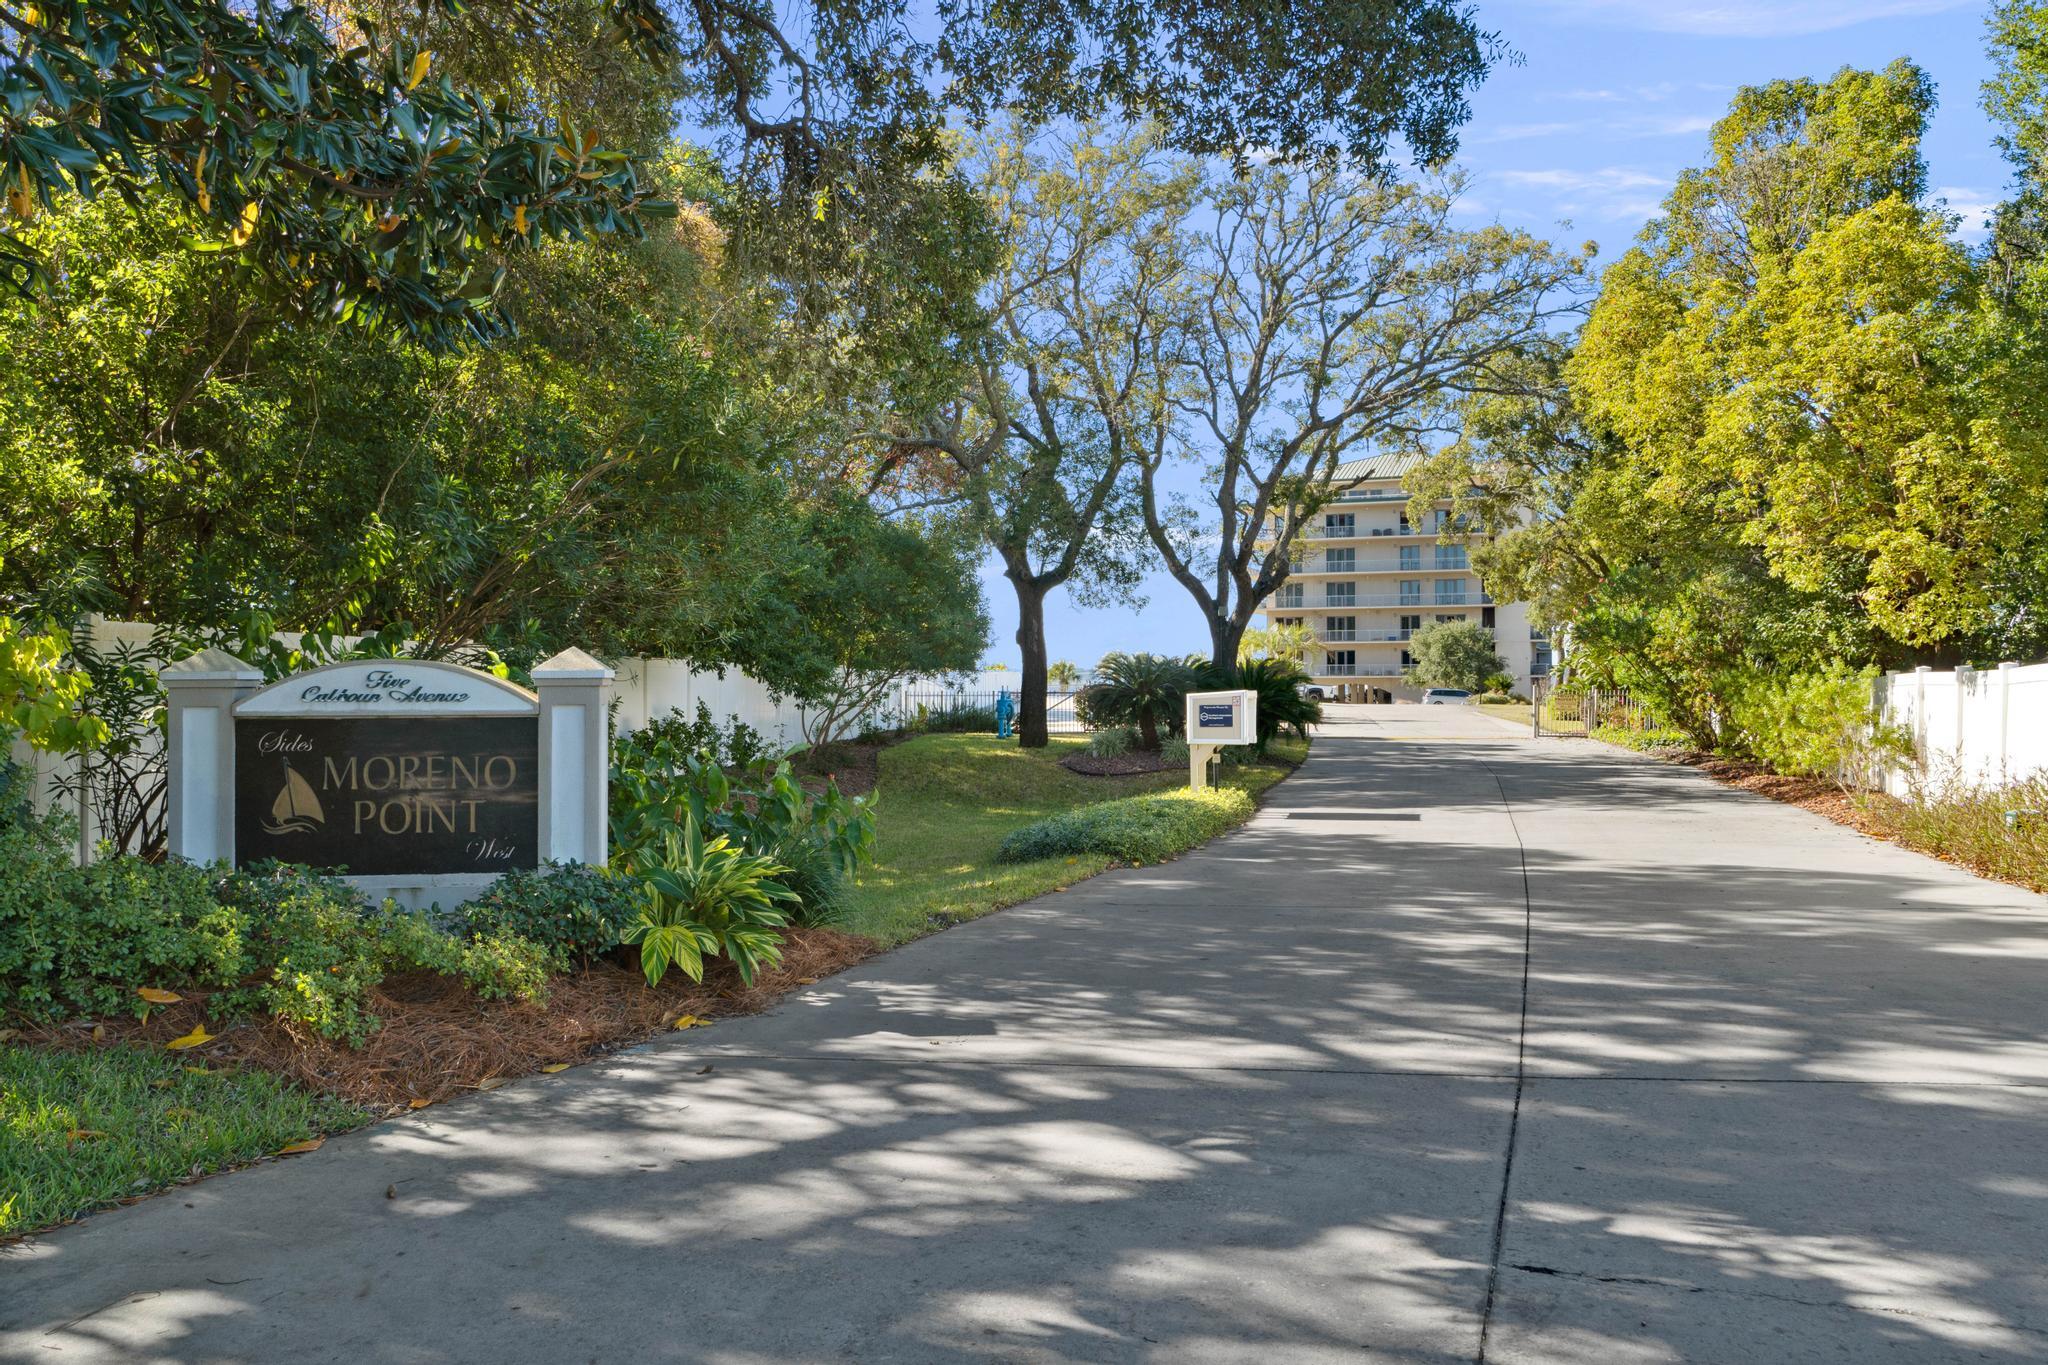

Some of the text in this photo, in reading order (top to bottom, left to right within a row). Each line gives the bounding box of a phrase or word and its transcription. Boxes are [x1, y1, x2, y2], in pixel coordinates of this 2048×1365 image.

[366, 670, 411, 689] Five
[301, 685, 471, 703] Calhoun Avenue
[258, 729, 313, 755] Sides
[322, 755, 517, 791] MORENO
[354, 799, 487, 835] POINT
[466, 838, 516, 860] West
